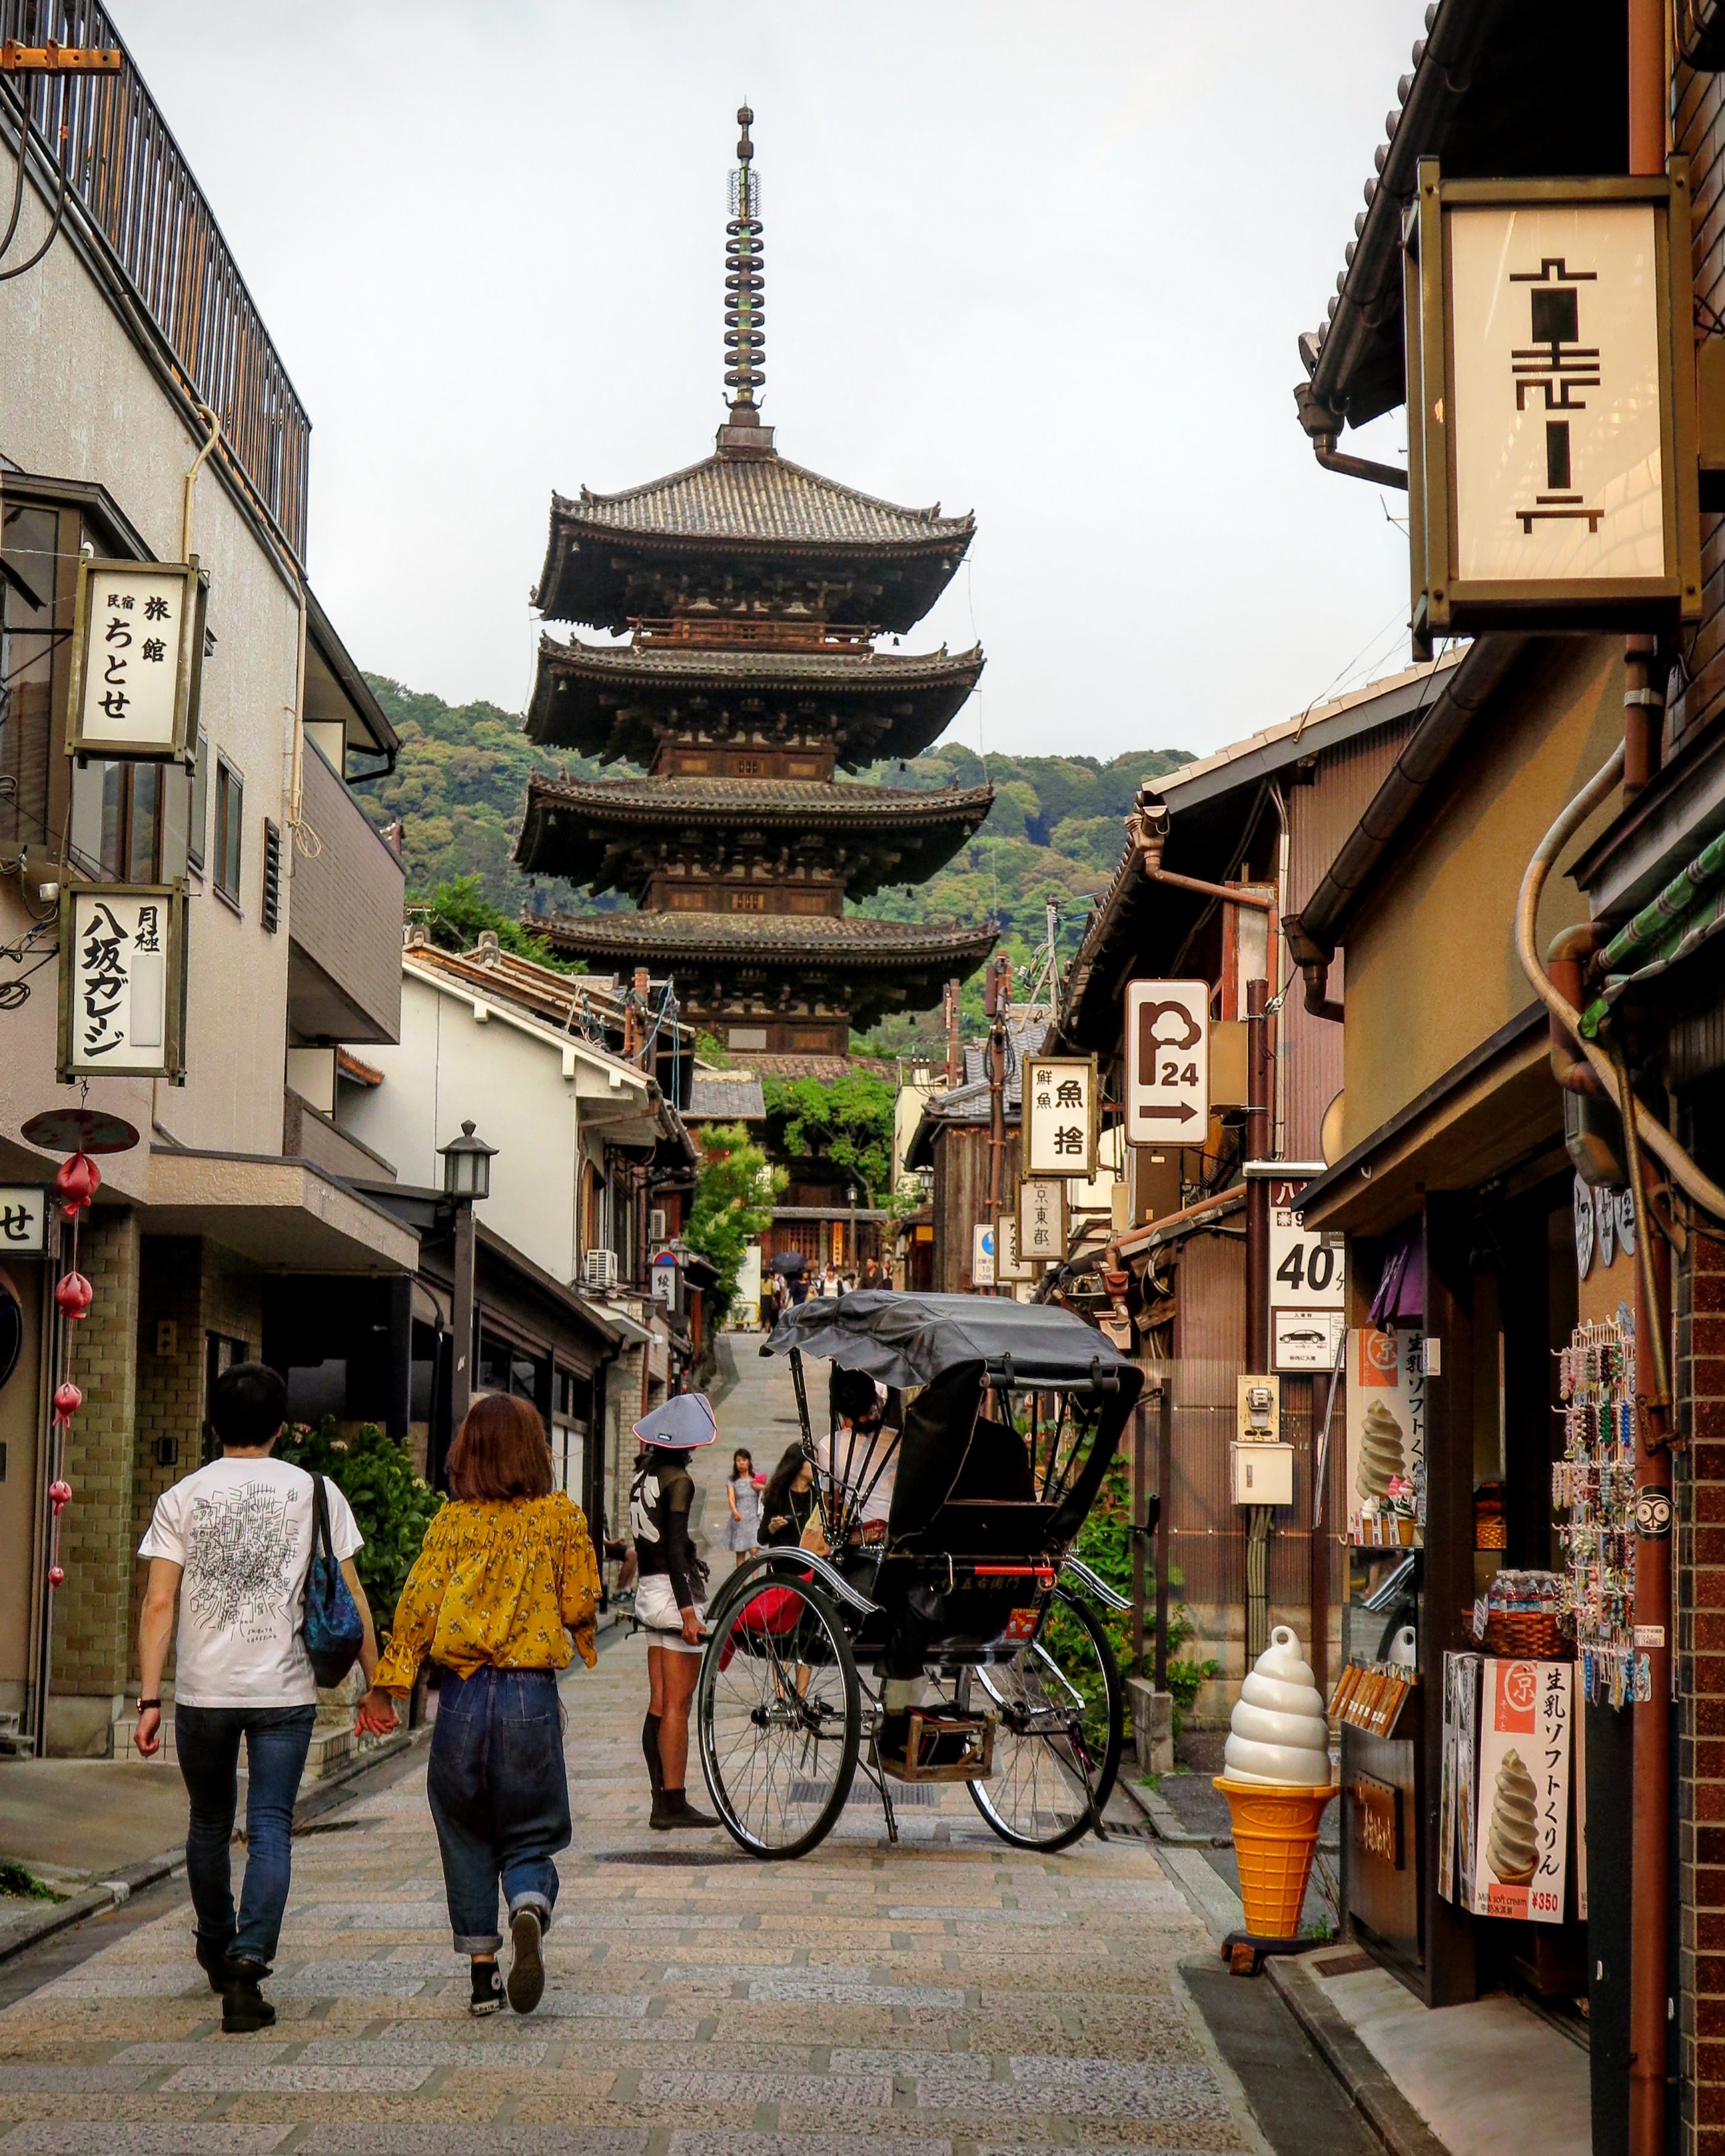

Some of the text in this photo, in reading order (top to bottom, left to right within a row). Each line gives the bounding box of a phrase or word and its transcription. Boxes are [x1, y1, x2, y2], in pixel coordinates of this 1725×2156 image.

[107, 594, 136, 610] 民宿
[142, 596, 172, 663] 旅館
[98, 617, 132, 719] ちとせ
[134, 905, 160, 953] 月極
[81, 902, 128, 1057] 八坂ガレージ
[1036, 1069, 1053, 1109] 鮮魚
[1162, 1062, 1199, 1087] 24
[1054, 1080, 1084, 1155] 魚捨
[1275, 1182, 1307, 1204] 八
[0, 1204, 34, 1241] せ
[246, 1633, 277, 1644] CROSSING
[247, 1627, 273, 1635] SHIBUYA
[1539, 1667, 1567, 1876] 生乳ソフトくりん
[1493, 1894, 1506, 1904] soft
[1507, 1897, 1528, 1907] cream
[1532, 1891, 1559, 1912] ¥350
